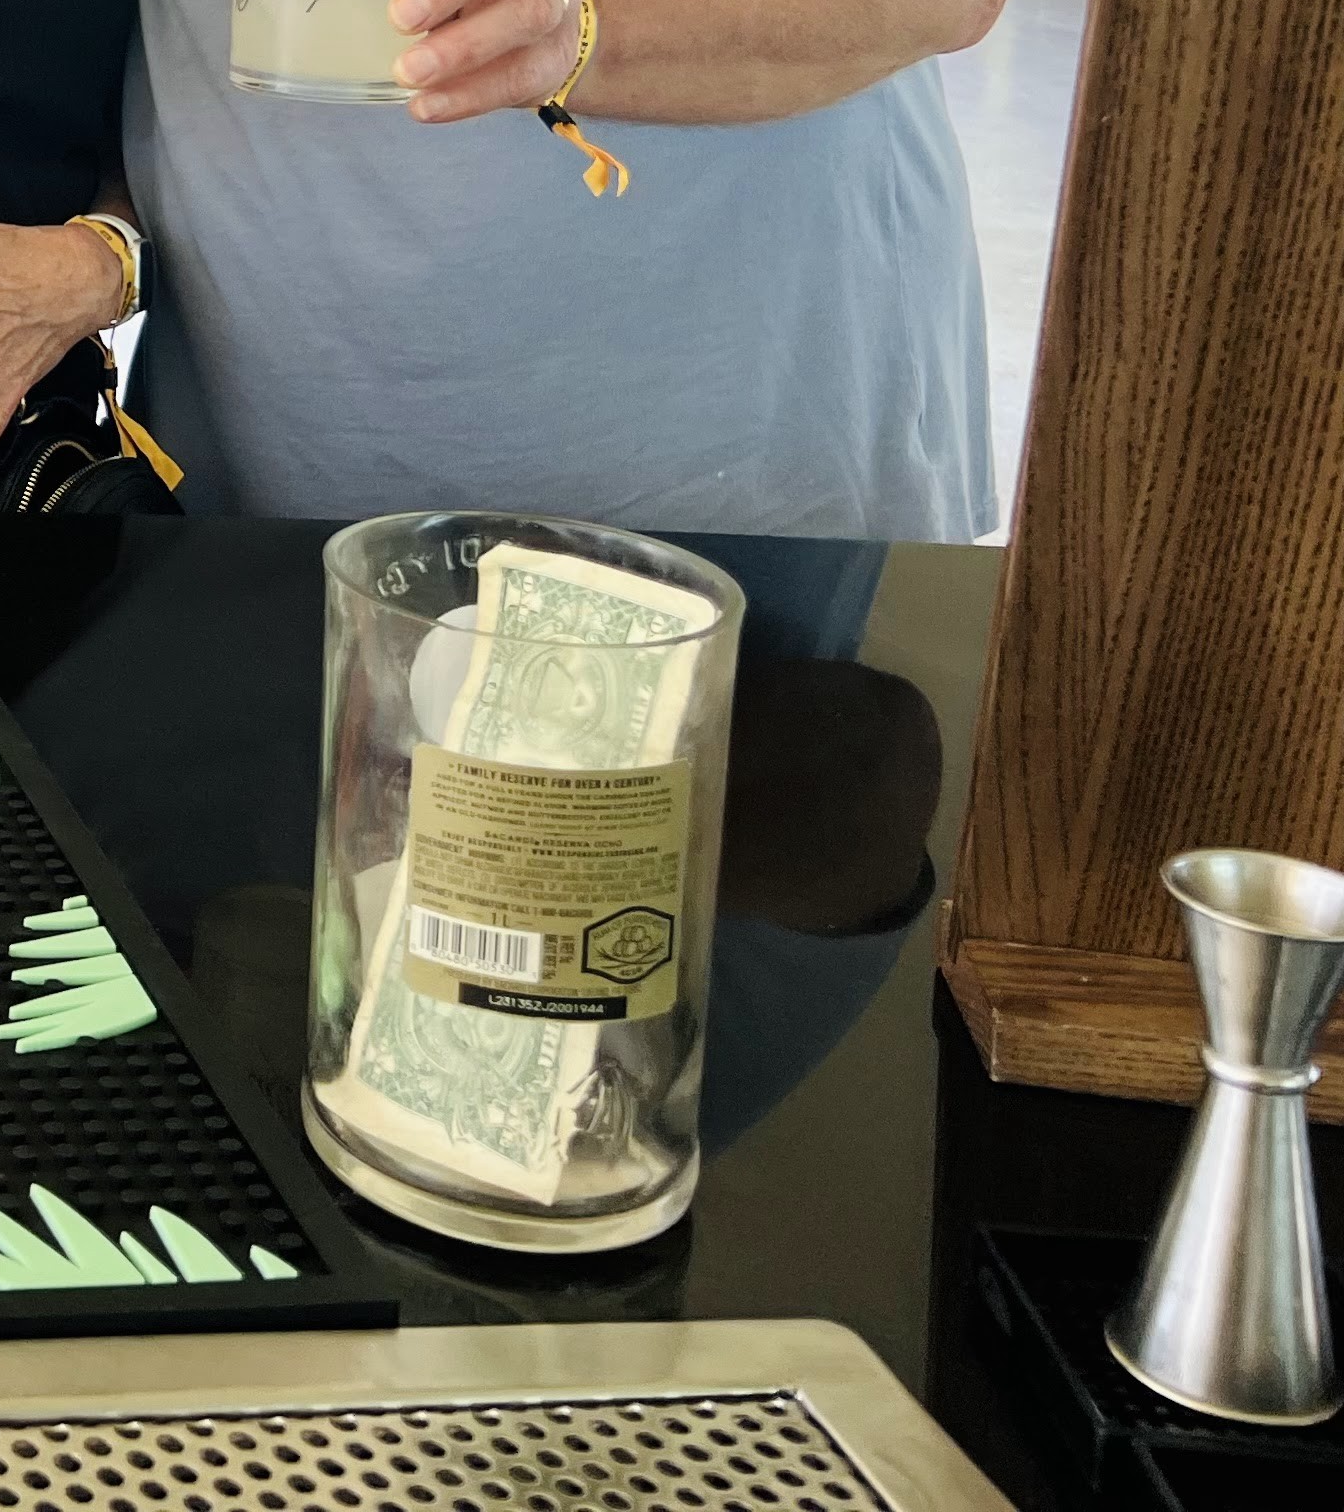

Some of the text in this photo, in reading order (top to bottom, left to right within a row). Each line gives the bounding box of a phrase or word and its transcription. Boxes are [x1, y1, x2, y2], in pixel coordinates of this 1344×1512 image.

[458, 763, 496, 780] FAMILY
[501, 773, 547, 787] RESERVE
[551, 777, 570, 788] FOR
[575, 778, 601, 789] OVER
